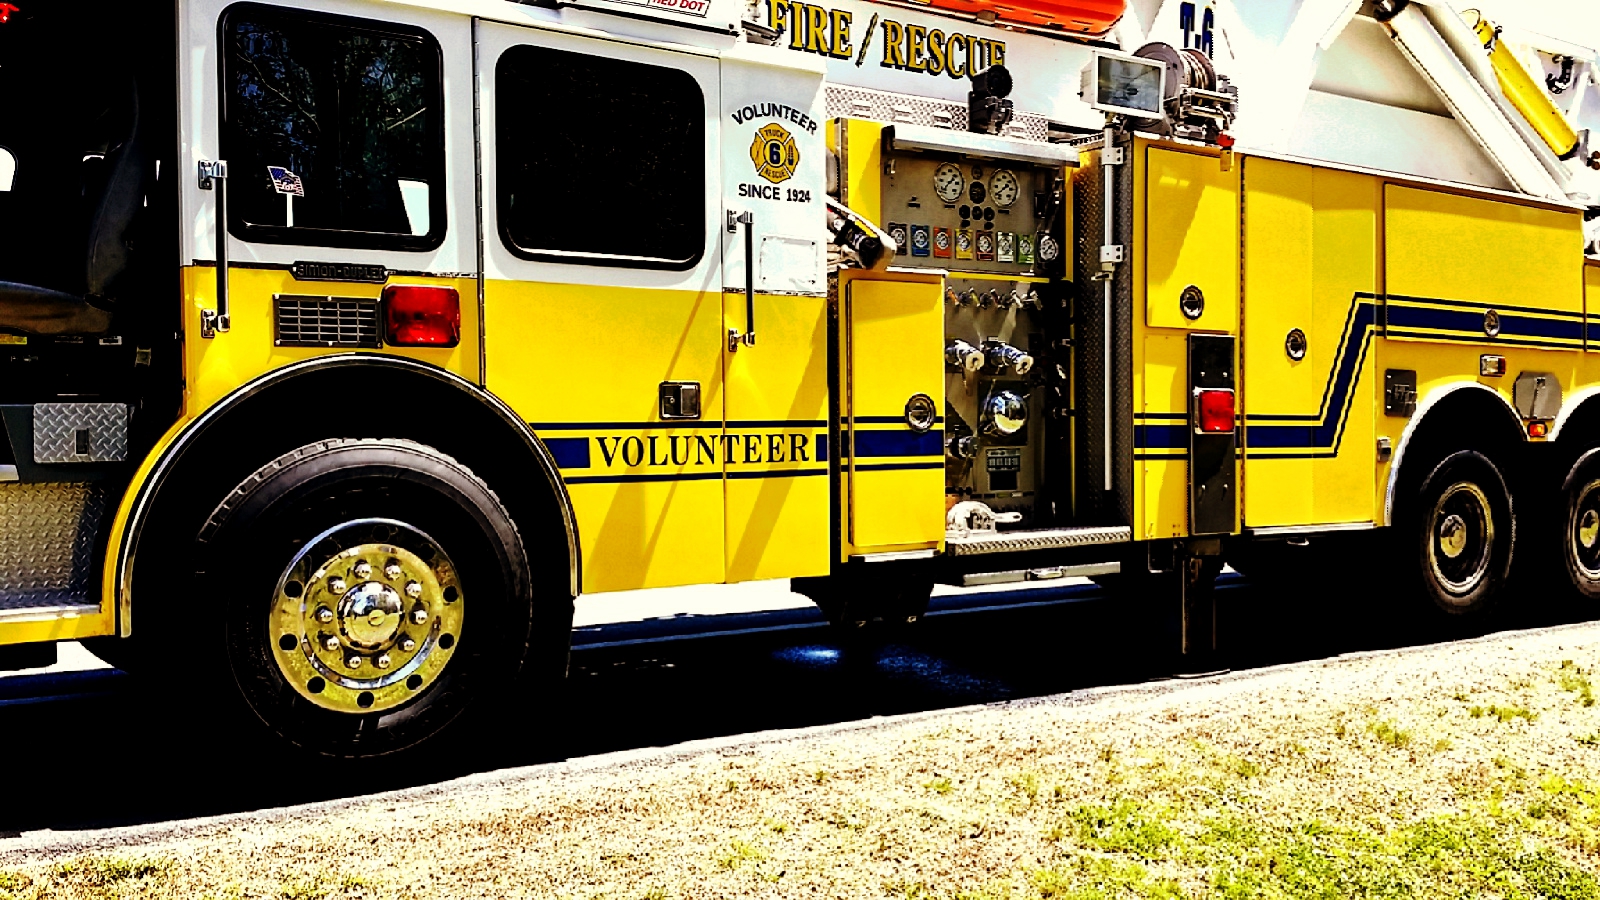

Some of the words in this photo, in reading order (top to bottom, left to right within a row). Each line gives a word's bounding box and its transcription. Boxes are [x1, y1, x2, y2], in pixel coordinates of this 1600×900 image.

[680, 0, 706, 11] DOT
[765, 0, 852, 60] FIRE
[880, 19, 1006, 79] RESCUE
[731, 102, 817, 135] VOLUNTEER
[770, 142, 781, 165] 6
[738, 183, 781, 201] SINCE
[786, 188, 811, 203] 1924
[595, 433, 809, 467] VOLUNTEER
